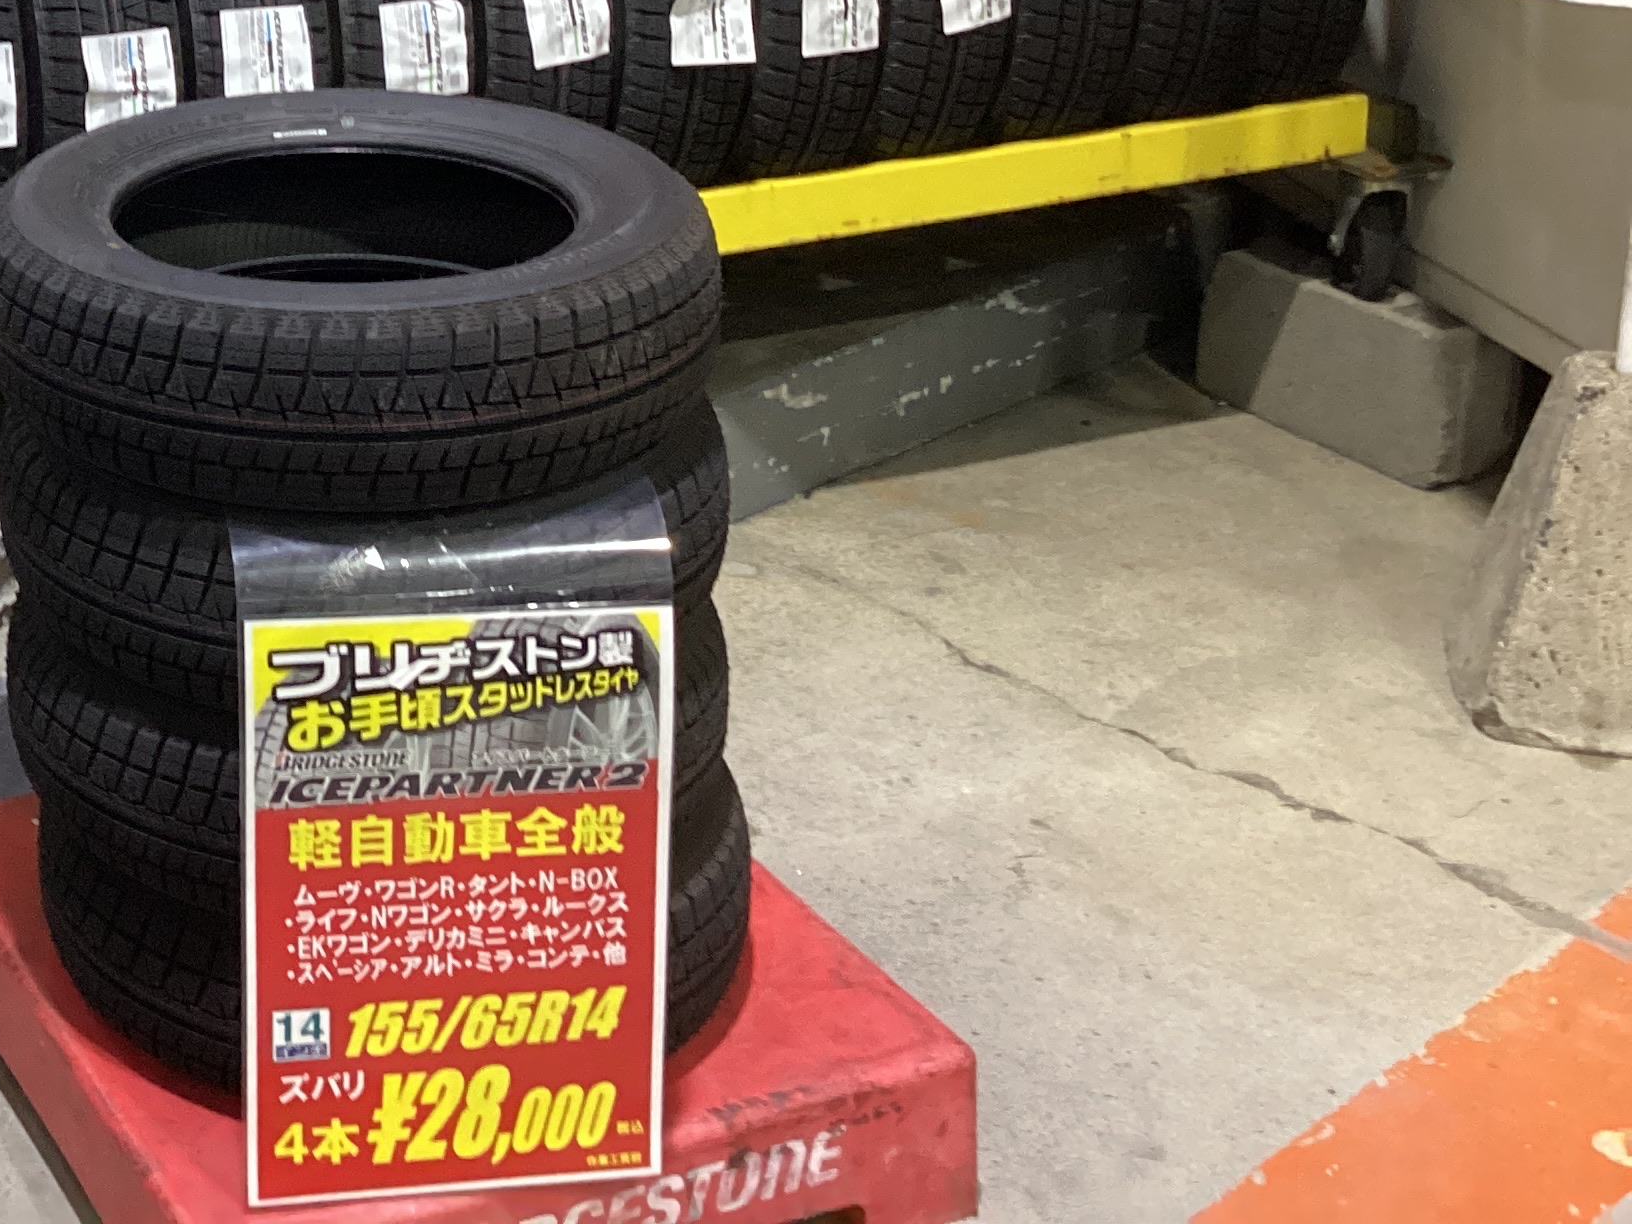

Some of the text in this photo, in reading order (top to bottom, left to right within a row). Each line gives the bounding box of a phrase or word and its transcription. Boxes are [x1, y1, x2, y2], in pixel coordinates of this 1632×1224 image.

[272, 631, 634, 701] ブリヂストン製
[287, 669, 639, 751] お手頃スタッドレスタイヤ
[288, 804, 625, 871] 軽自動車全般
[276, 1012, 325, 1043] 14
[344, 985, 628, 1058] 155/65R14
[273, 1118, 360, 1165] 4本
[367, 1064, 617, 1165] ¥28,000
[278, 1070, 366, 1105] ズバリ
